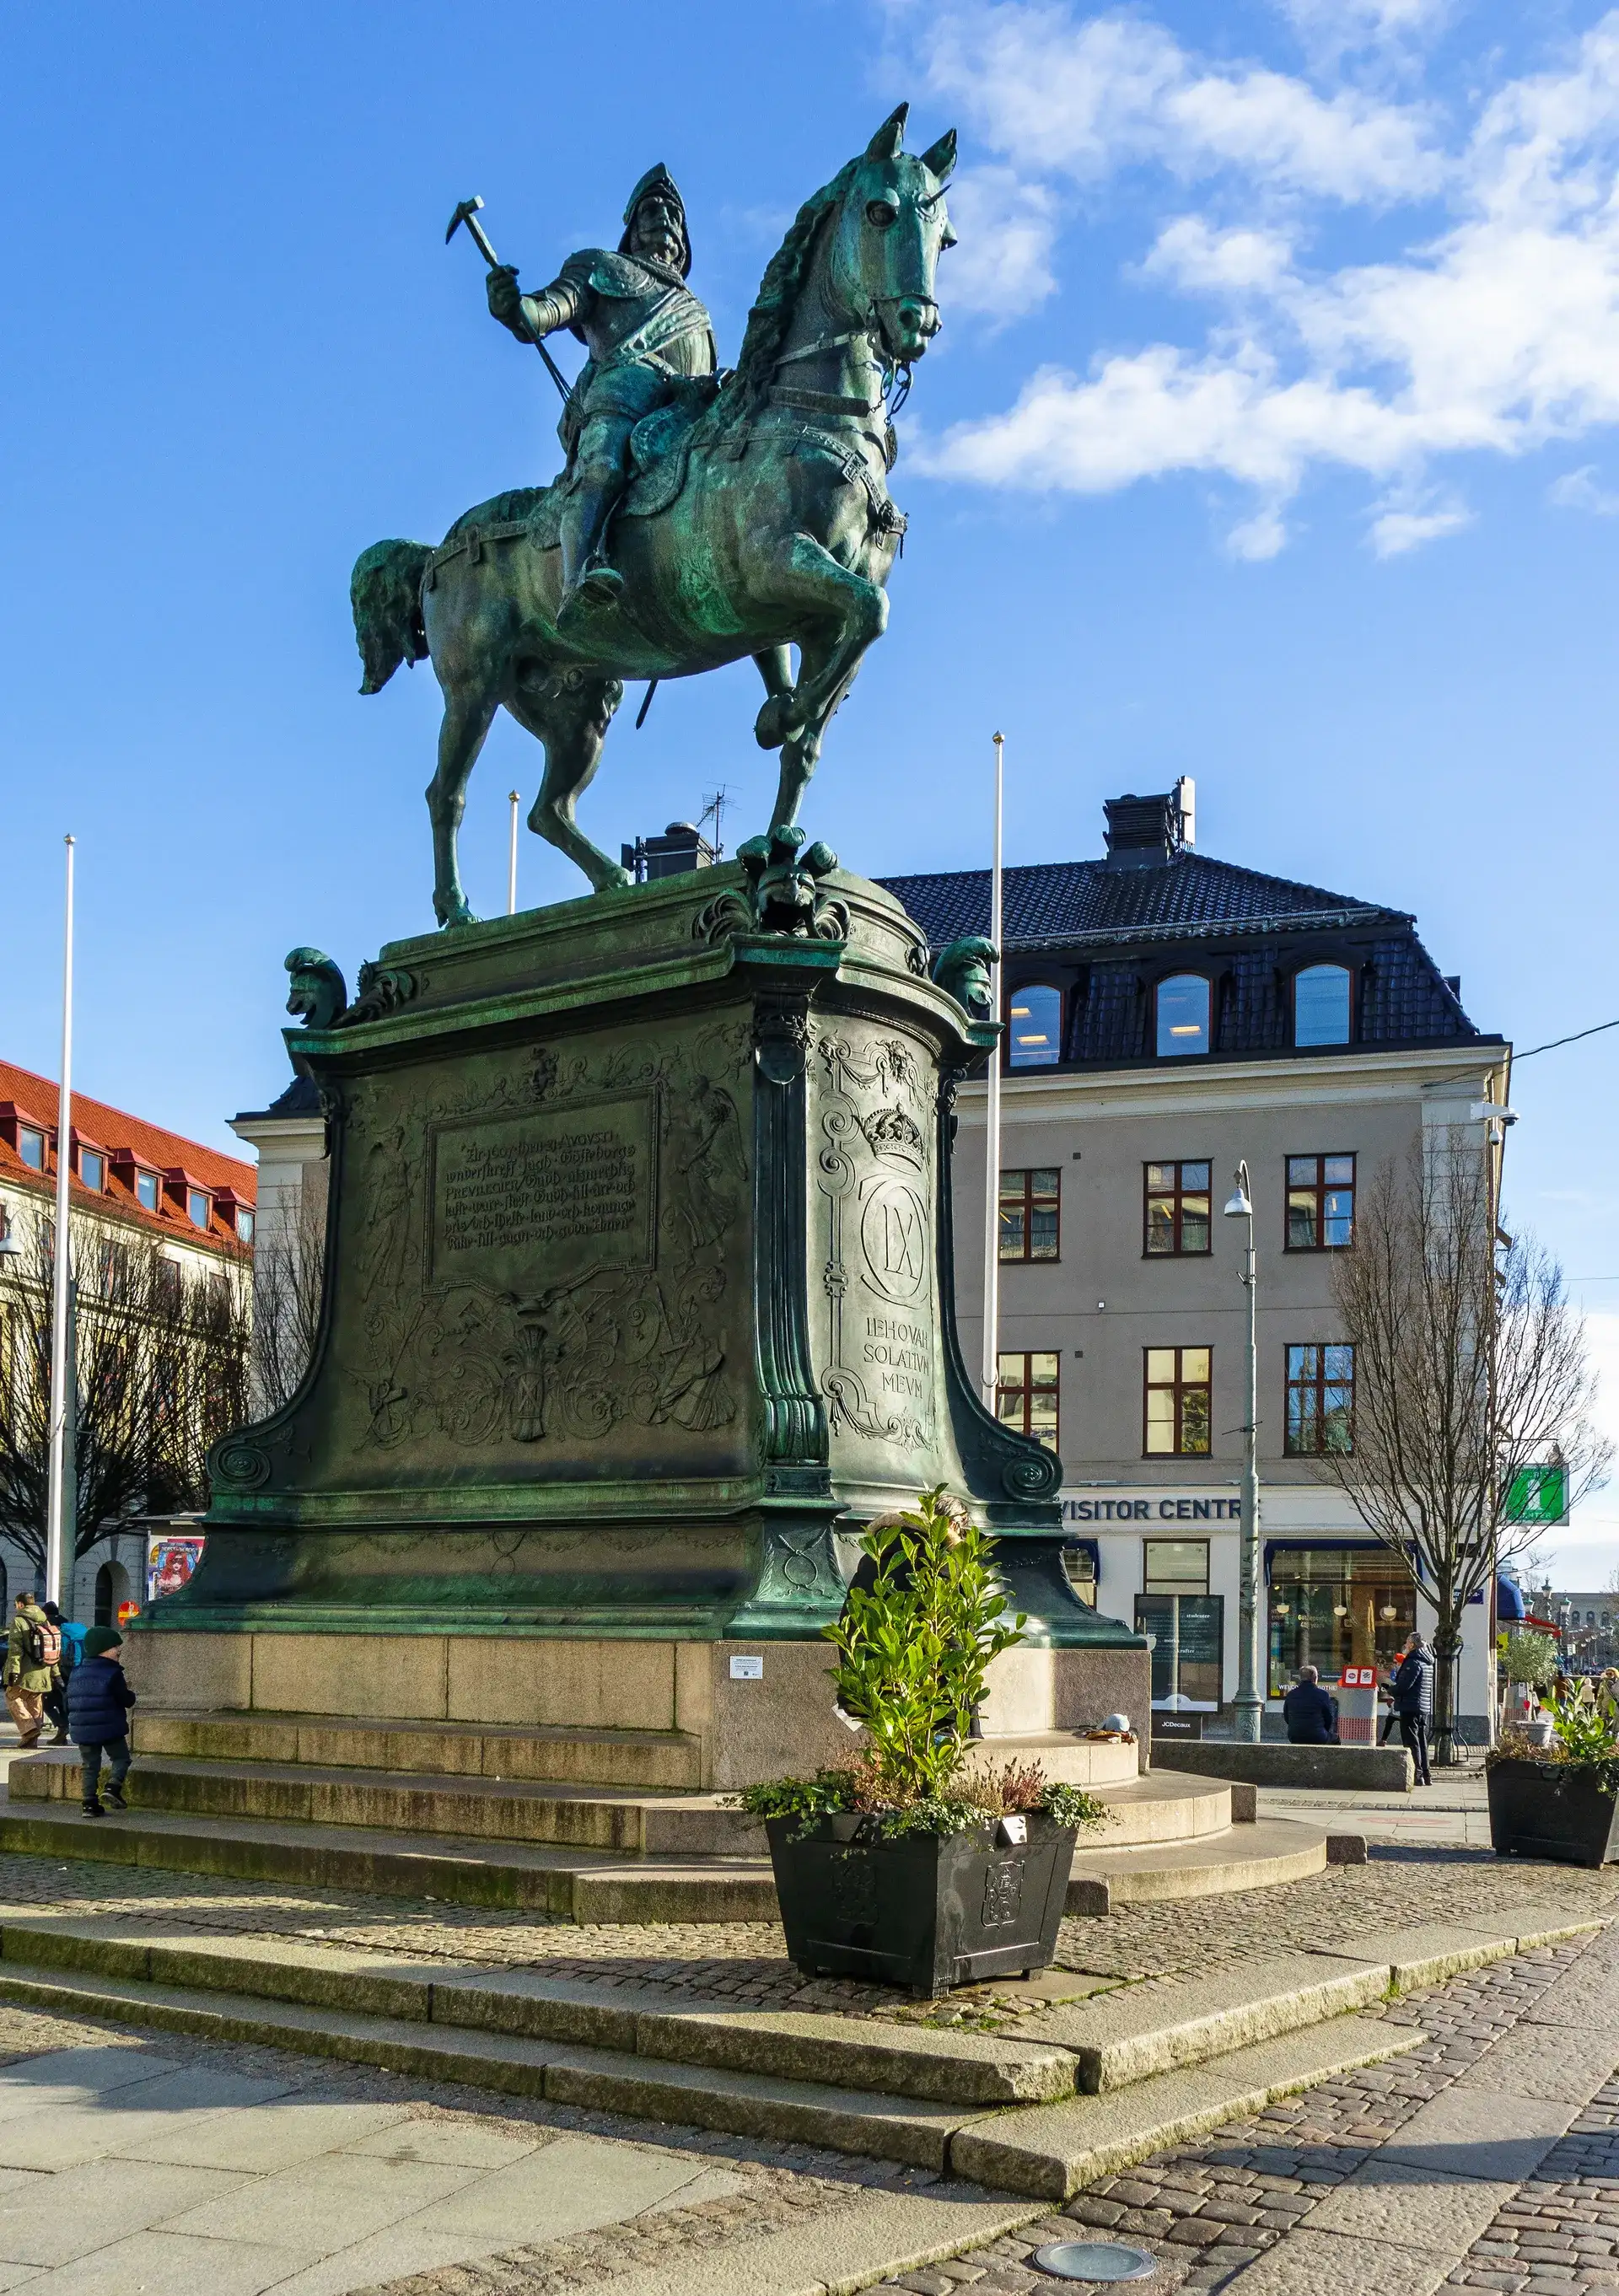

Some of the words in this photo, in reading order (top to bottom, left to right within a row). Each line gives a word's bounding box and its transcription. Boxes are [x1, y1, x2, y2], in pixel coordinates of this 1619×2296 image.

[881, 1372, 924, 1400] MEVM
[1159, 1499, 1261, 1520] CENTR
[1161, 1721, 1191, 1729] JCDecaux
